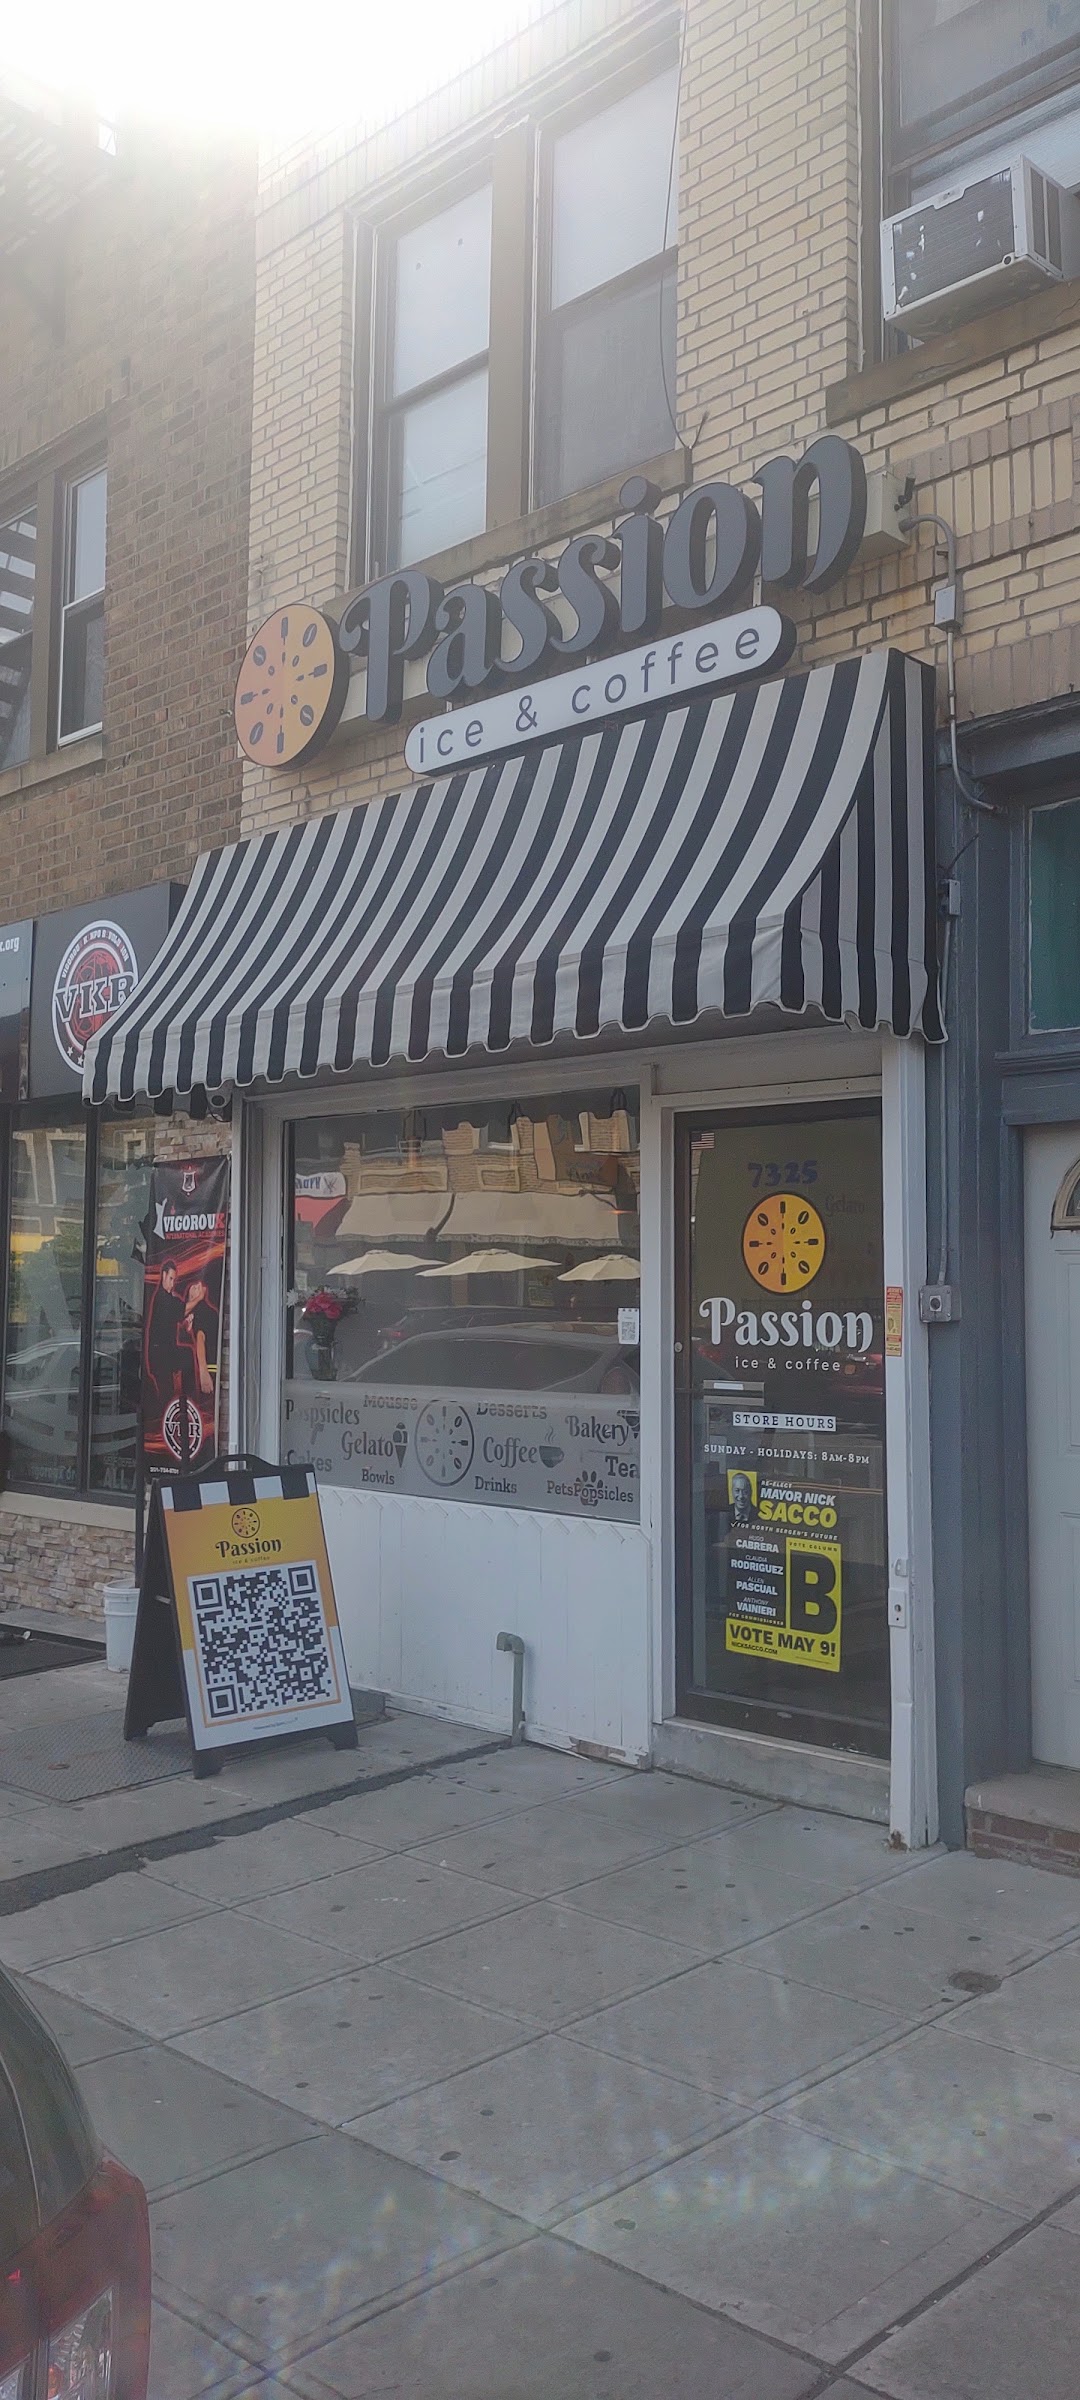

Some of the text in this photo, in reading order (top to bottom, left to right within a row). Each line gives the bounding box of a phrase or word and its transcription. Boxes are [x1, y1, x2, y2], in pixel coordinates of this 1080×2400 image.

[339, 435, 868, 723] Passion
[418, 627, 760, 764] ice & coffee
[54, 971, 136, 1022] VKR
[748, 1160, 818, 1188] 7325
[163, 1213, 225, 1232] VIGOROUK
[699, 1297, 873, 1353] Passion
[735, 1356, 841, 1372] ice & coffee
[363, 1395, 418, 1411] Mousse
[476, 1402, 548, 1419] Desserts
[735, 1413, 835, 1429] STORE HOURS
[565, 1415, 629, 1446] Bakery
[341, 1431, 394, 1460] Gelato
[483, 1437, 538, 1468] Coffee
[704, 1444, 747, 1455] SUNDAY
[758, 1447, 818, 1461] HOLIDAYS:
[822, 1452, 869, 1464] 8AM-8PM
[362, 1467, 395, 1484] Bowls
[605, 1456, 640, 1478] Tea
[474, 1476, 517, 1493] Drinks
[761, 1480, 793, 1489] RE-ELECT
[760, 1488, 836, 1506] MAYOR NICK
[758, 1500, 837, 1528] SACCO
[751, 1524, 774, 1532] NORTH
[776, 1527, 808, 1537] BERGEN'S
[811, 1532, 838, 1541] FUTURE
[215, 1538, 281, 1558] Passion
[736, 1539, 779, 1553] CABRERA
[809, 1544, 837, 1552] COLUMN
[731, 1559, 784, 1575] RODRIGUEZ
[736, 1581, 778, 1596] PASCUAL
[748, 1576, 764, 1584] ALLEN
[743, 1597, 769, 1605] ANTHONY
[790, 1550, 838, 1635] B
[736, 1601, 776, 1617] VAINIERI
[729, 1624, 836, 1657] VOTE MAY 9!
[731, 1641, 778, 1655] NICKSACCO.COM
